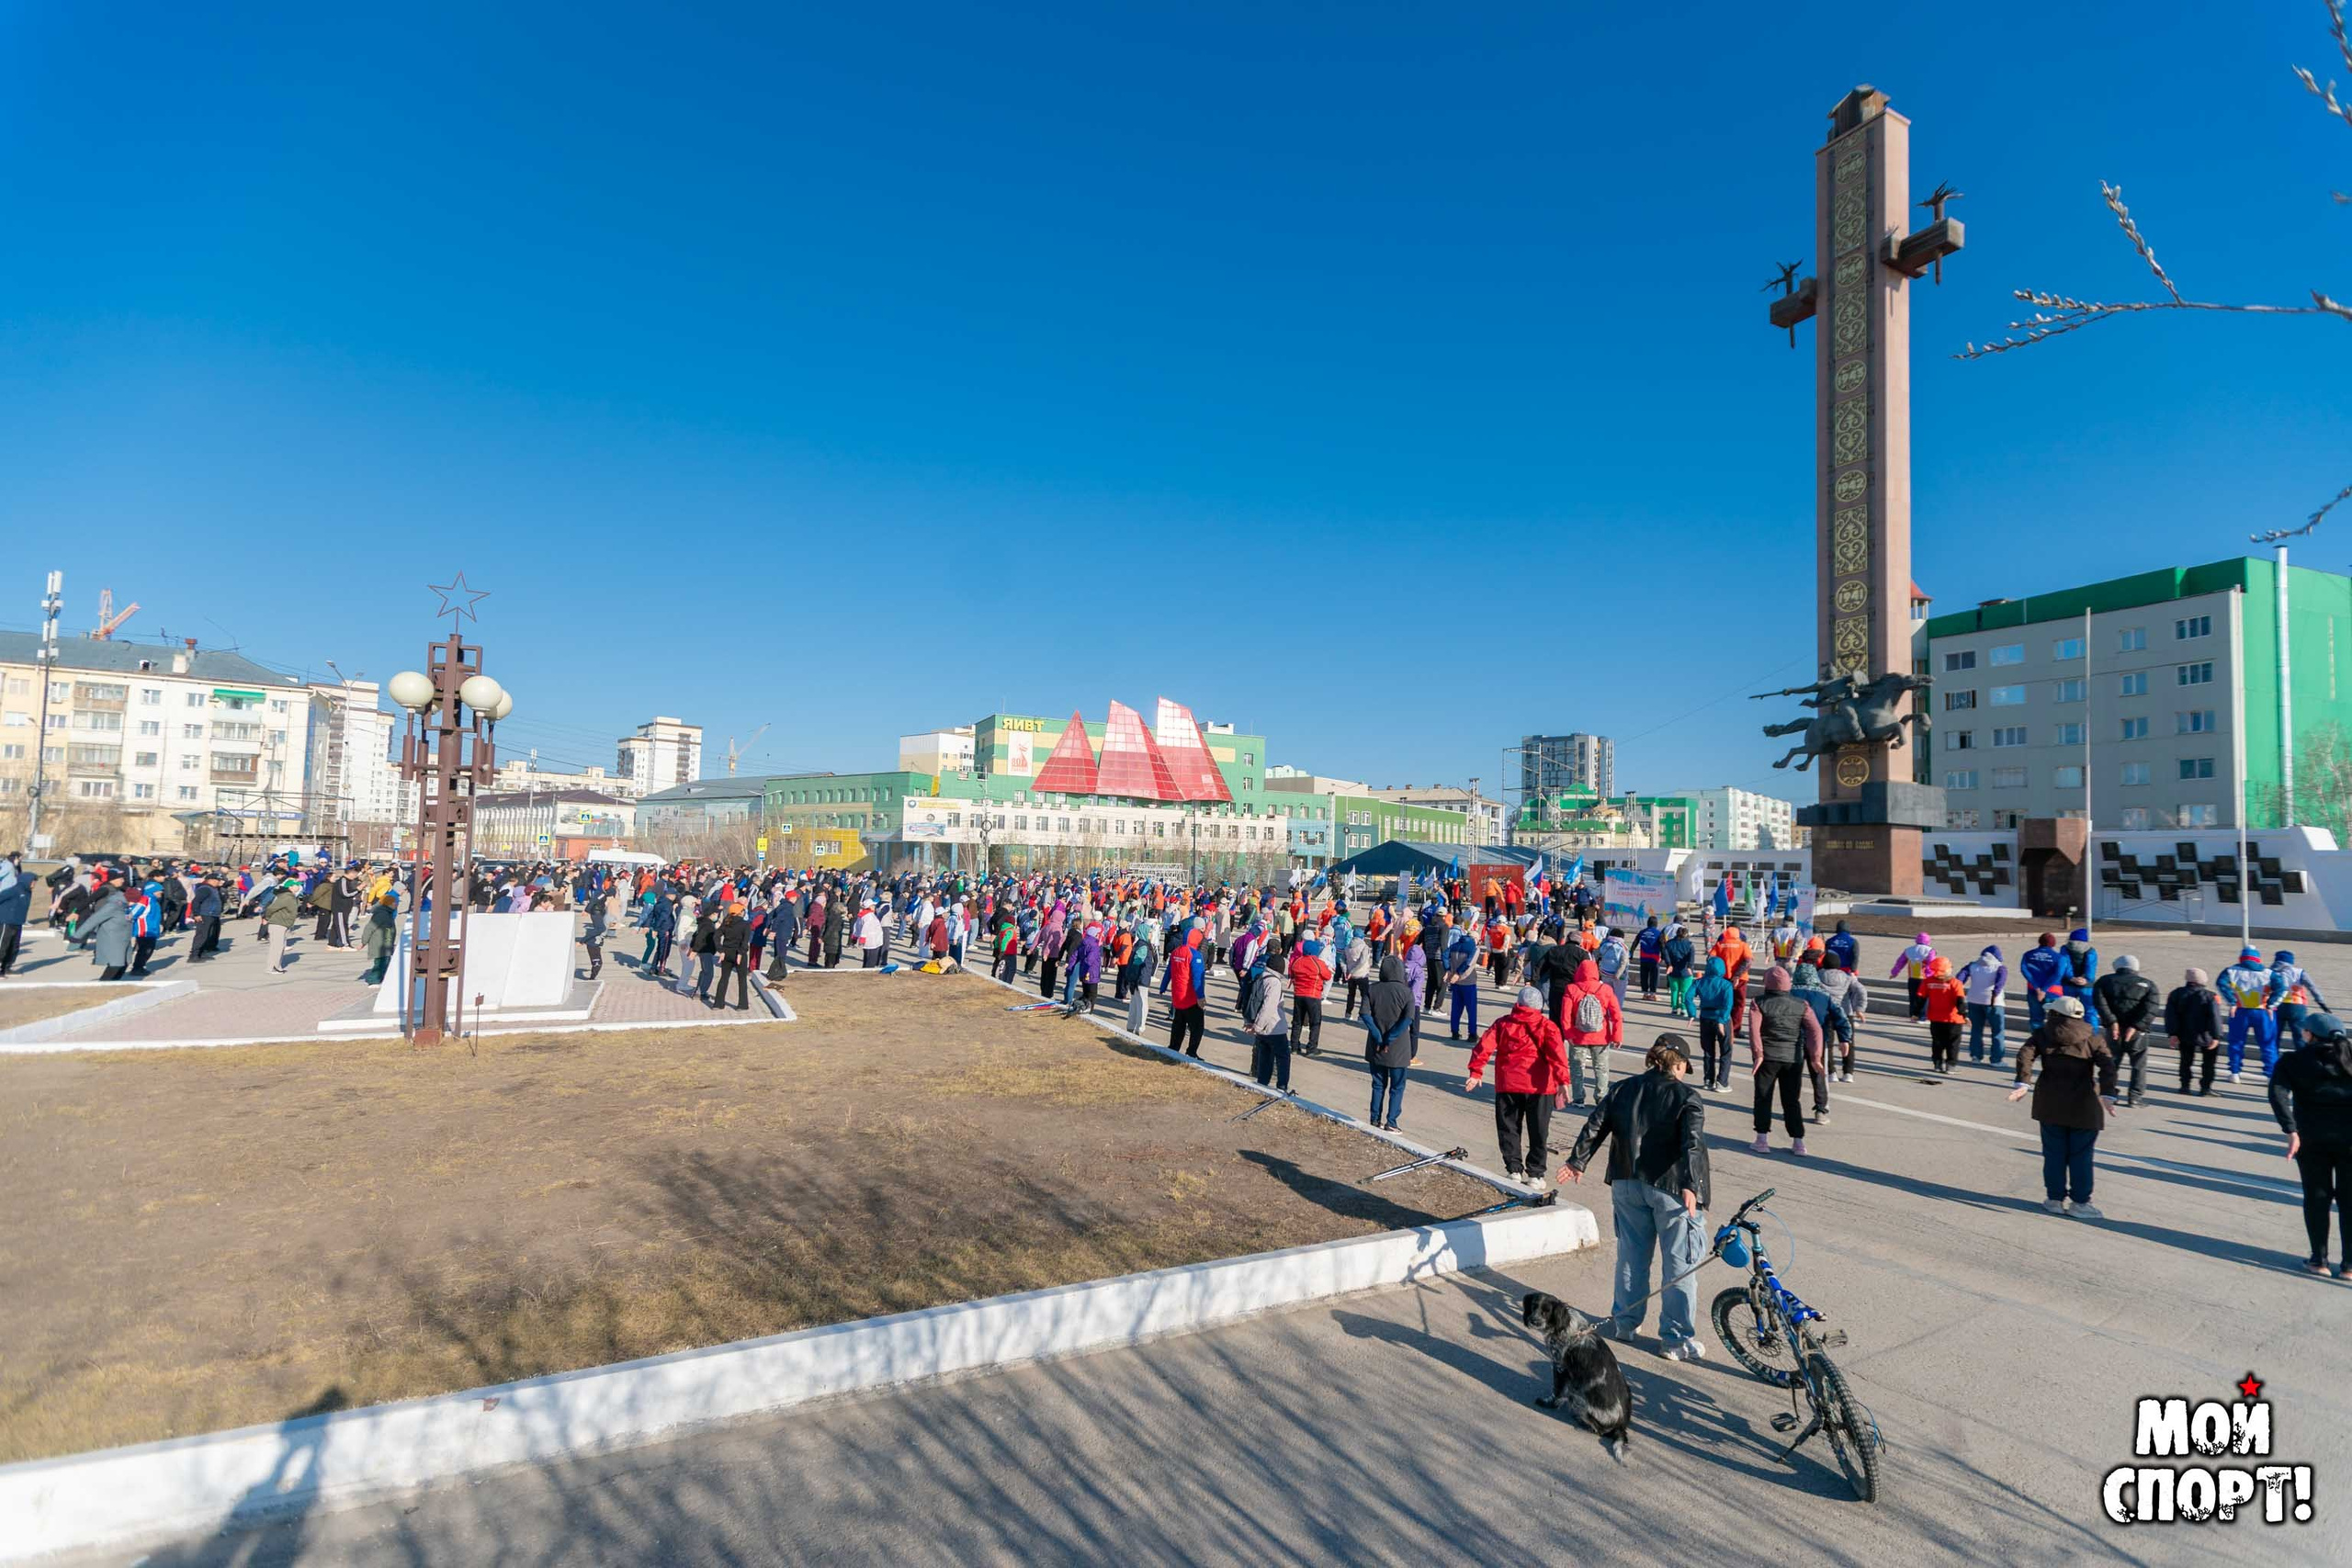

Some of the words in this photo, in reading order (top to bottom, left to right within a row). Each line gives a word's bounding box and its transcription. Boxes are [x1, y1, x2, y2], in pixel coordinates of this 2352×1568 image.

[1838, 261, 1863, 281] 1944
[1838, 367, 1863, 386] 1943
[1838, 478, 1864, 494] 1942
[1838, 589, 1864, 604] 1941
[1003, 718, 1044, 732] ЯИВТ
